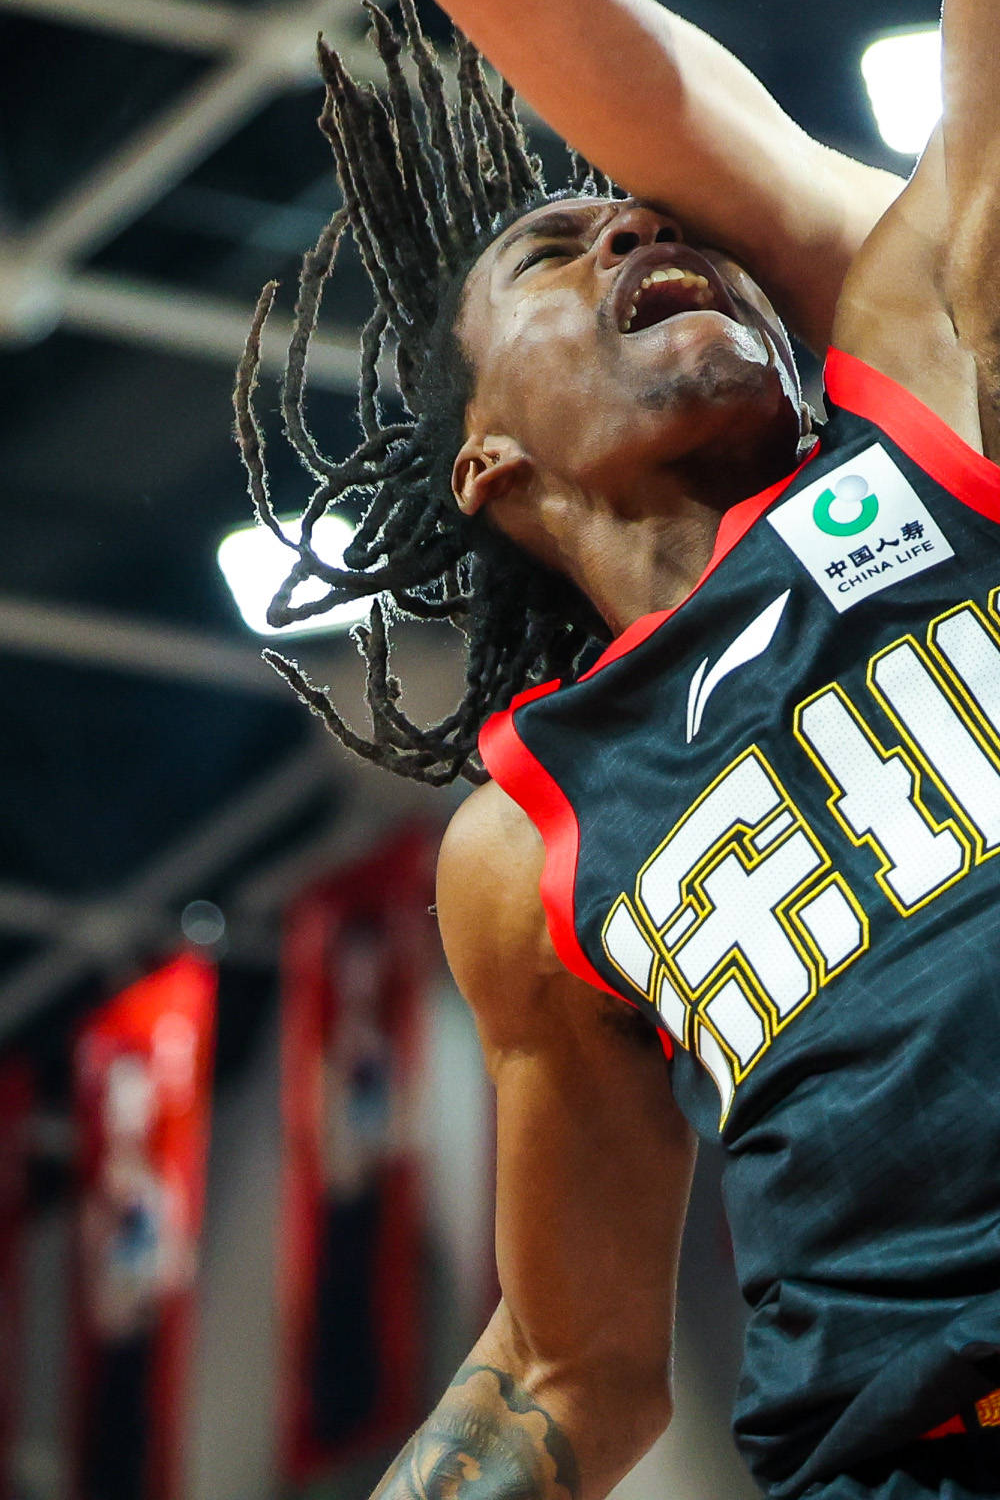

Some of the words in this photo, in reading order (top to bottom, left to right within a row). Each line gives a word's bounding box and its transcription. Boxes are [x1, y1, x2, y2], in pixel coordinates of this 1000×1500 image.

[824, 520, 925, 579] 中国人寿
[837, 561, 893, 593] CHINA
[896, 540, 935, 564] LIFE
